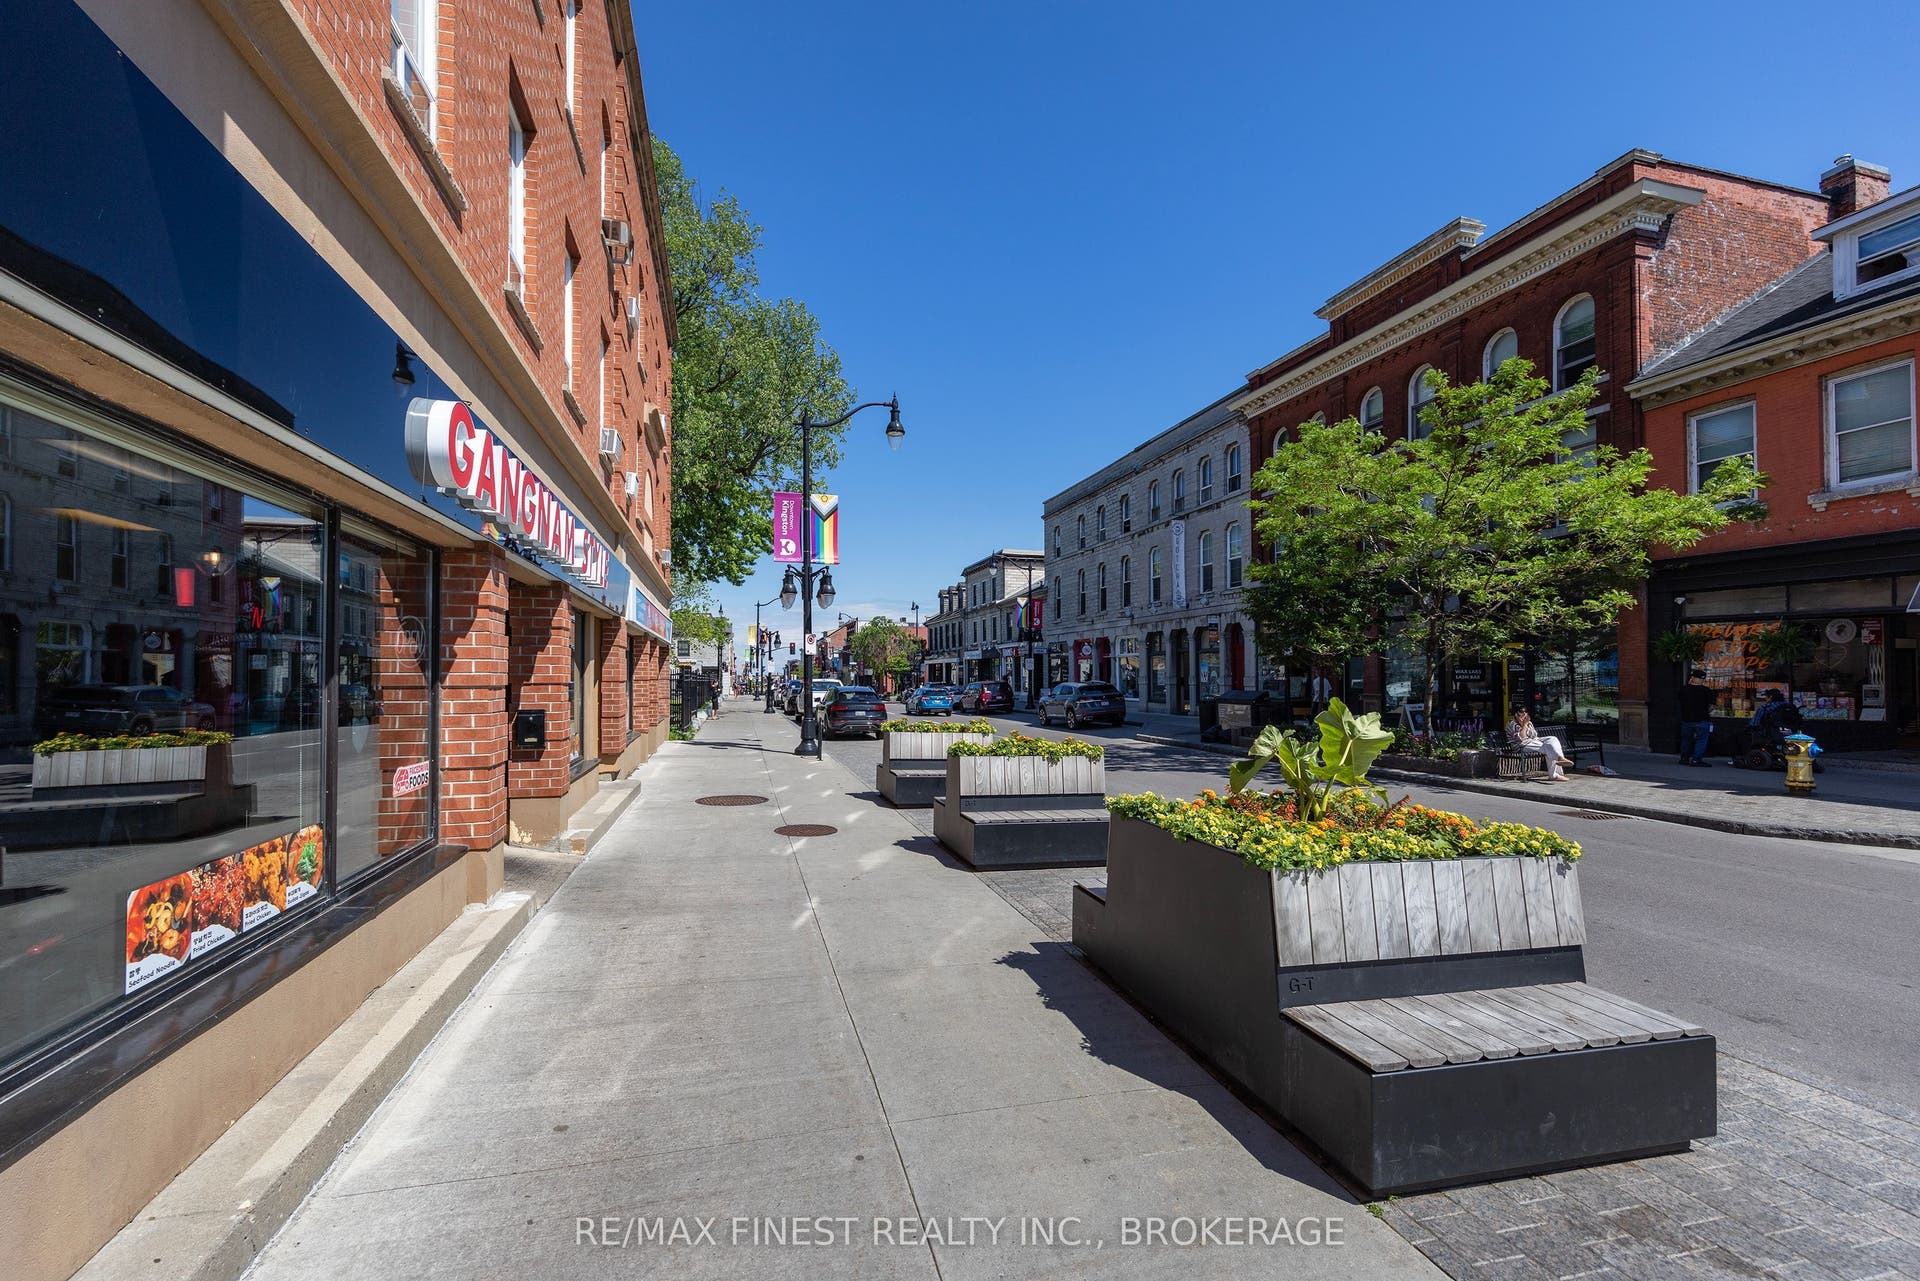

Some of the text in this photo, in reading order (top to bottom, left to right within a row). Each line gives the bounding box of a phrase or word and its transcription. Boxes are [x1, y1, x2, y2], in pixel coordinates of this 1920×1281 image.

[448, 401, 609, 590] GANGNAM STYLE
[781, 500, 790, 536] Kingston
[409, 771, 429, 789] FOODS
[256, 910, 272, 922] Chicken
[192, 934, 226, 955] Fried Chicken
[128, 960, 176, 989] Seafood Noodle
